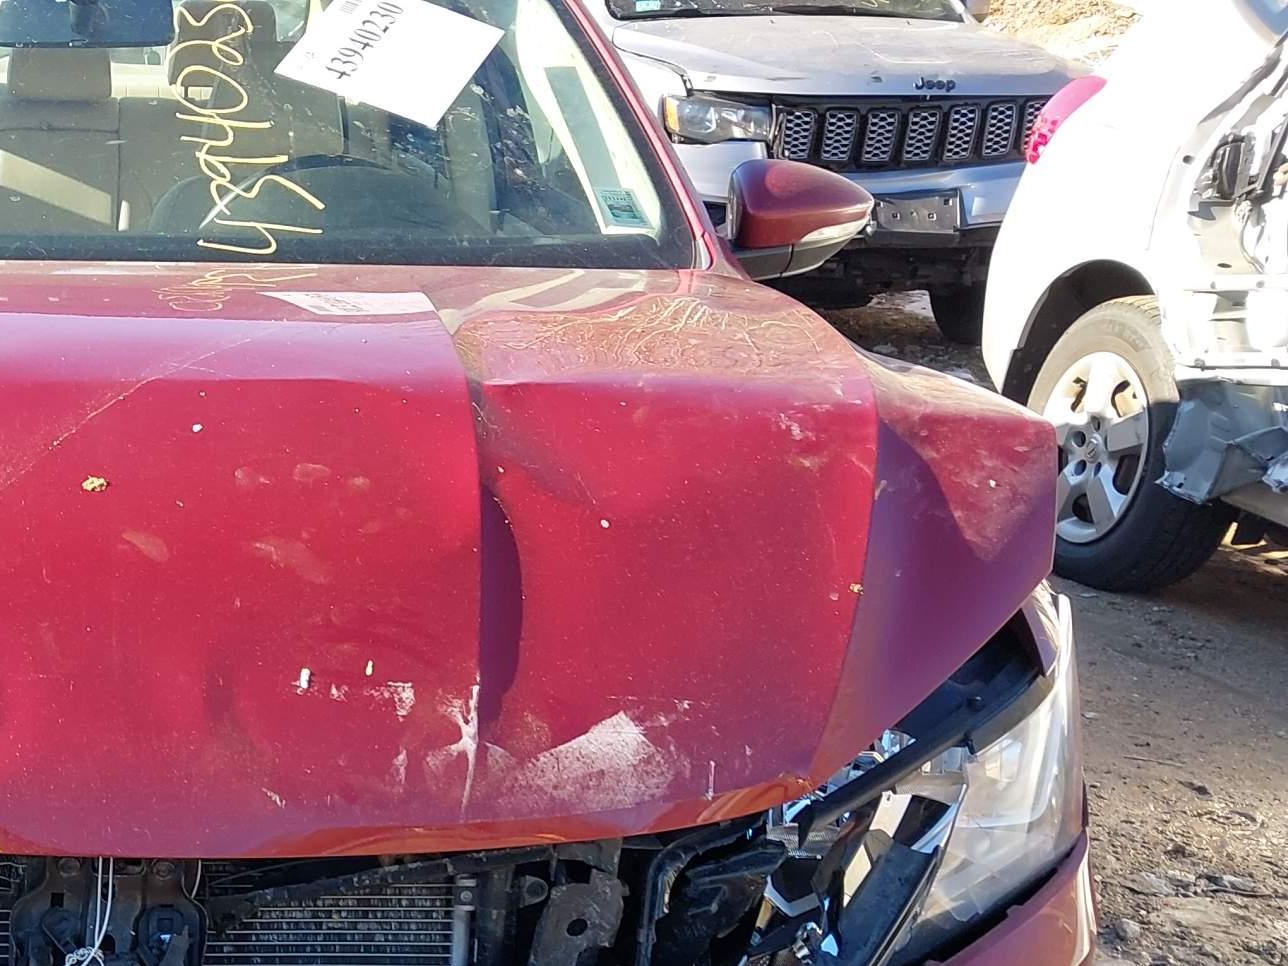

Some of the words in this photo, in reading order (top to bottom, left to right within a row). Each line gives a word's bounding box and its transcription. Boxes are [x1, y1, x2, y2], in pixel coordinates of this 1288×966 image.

[325, 1, 404, 79] 43940230
[914, 76, 956, 93] Jeep
[165, 0, 326, 255] 4394023
